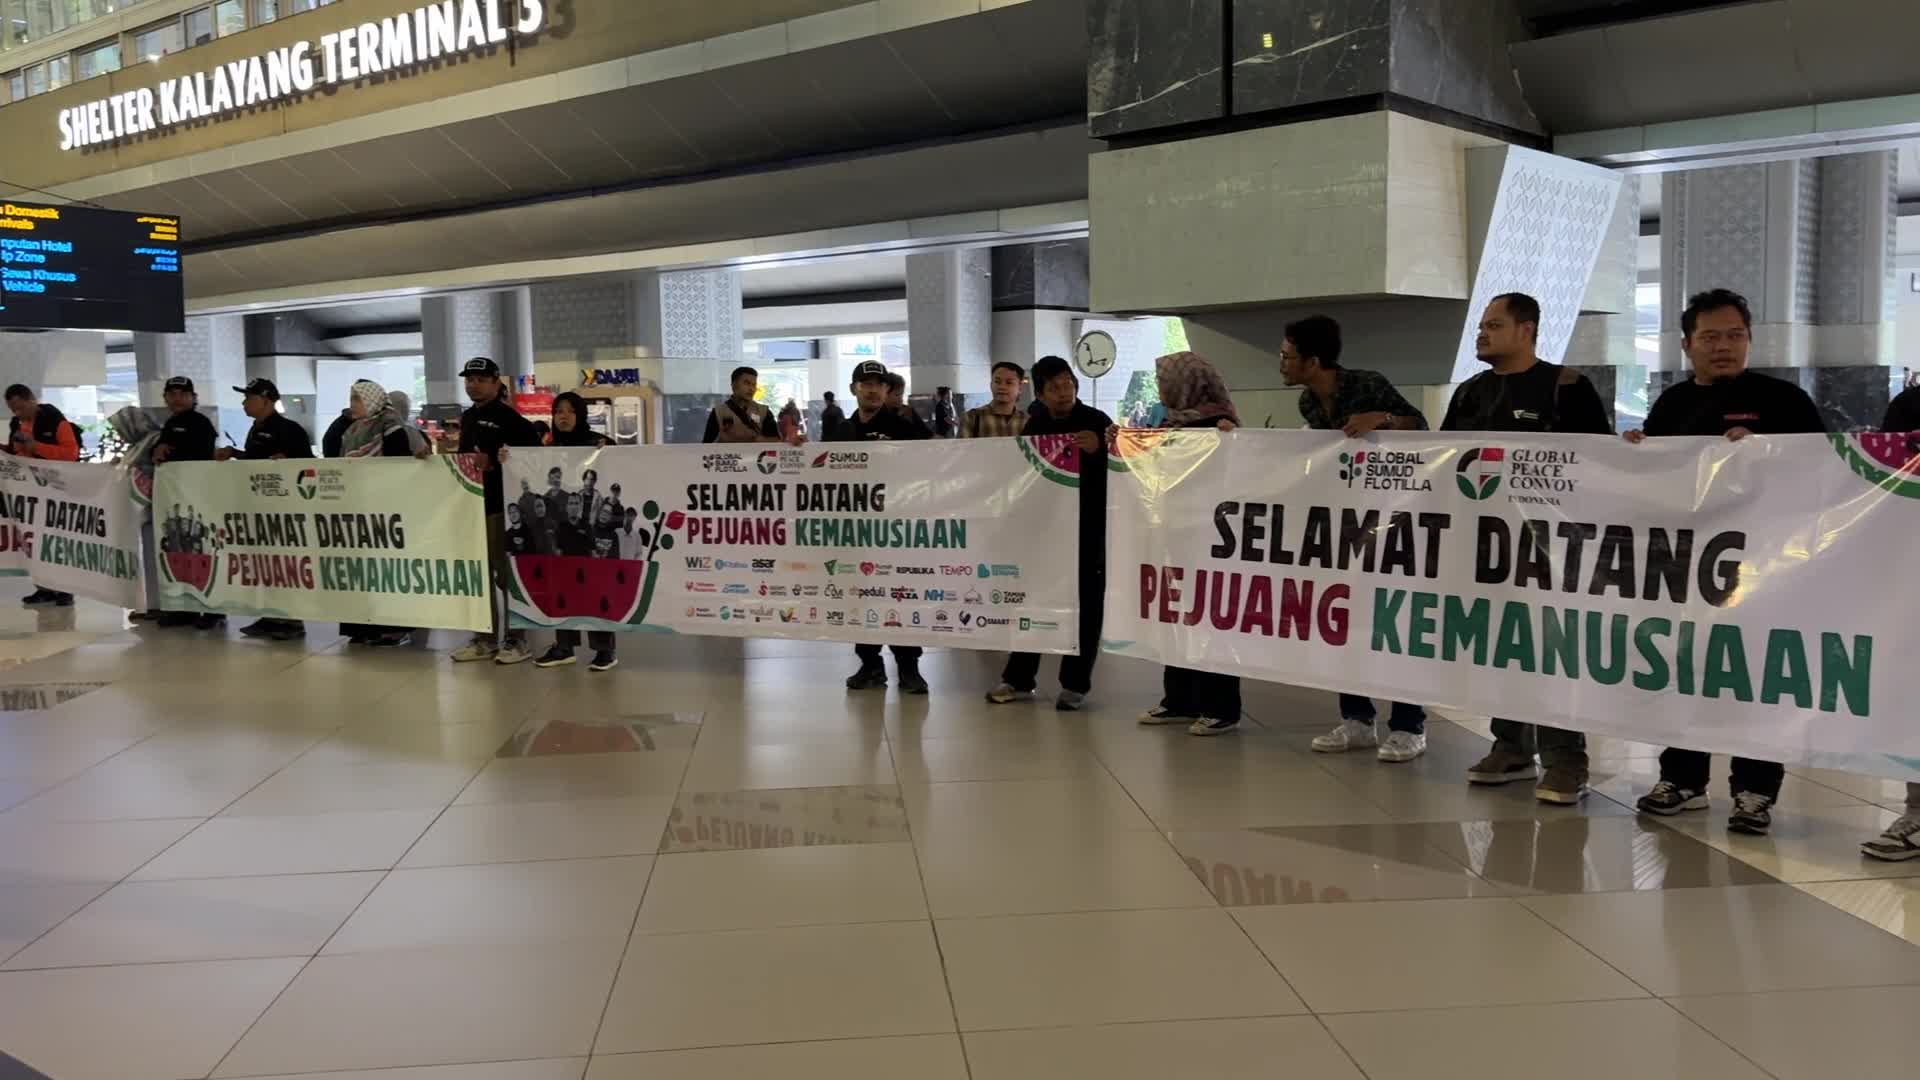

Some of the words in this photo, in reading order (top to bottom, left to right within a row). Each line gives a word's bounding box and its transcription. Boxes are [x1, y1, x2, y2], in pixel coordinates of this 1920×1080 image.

[58, 88, 156, 151] SHELTER
[159, 40, 313, 125] KALAYANG
[320, 0, 506, 84] TERMINAL
[5, 204, 60, 219] Domestik
[41, 240, 72, 252] Hotel
[15, 251, 46, 263] Zone
[1, 267, 32, 279] Sewa
[33, 269, 77, 282] Khusus
[2, 280, 46, 293] Vehicle
[829, 453, 869, 463] SUMUD
[1367, 451, 1425, 465] GLOBAL
[1512, 448, 1579, 465] GLOBAL
[1366, 465, 1414, 477] SUMUD
[1511, 463, 1563, 477] PEACE
[1364, 477, 1432, 492] FLOTILLA
[1510, 476, 1579, 492] CONVOY
[687, 483, 787, 511] SELAMAT
[796, 483, 886, 512] DATANG
[45, 498, 106, 537] DATANG
[223, 512, 307, 548] SELAMAT
[315, 513, 405, 549] DATANG
[687, 517, 786, 545] PEJUANG
[795, 518, 967, 548] KEMANUSIAAN
[1211, 501, 1451, 578] SELAMAT
[1475, 515, 1747, 608] DATANG
[227, 553, 315, 590] PEJUANG
[319, 556, 484, 598] KEMANUSIAAN
[939, 565, 973, 576] TEMPO
[1140, 563, 1351, 646] PEJUANG
[1371, 587, 1873, 717] KEMANUSIAAN
